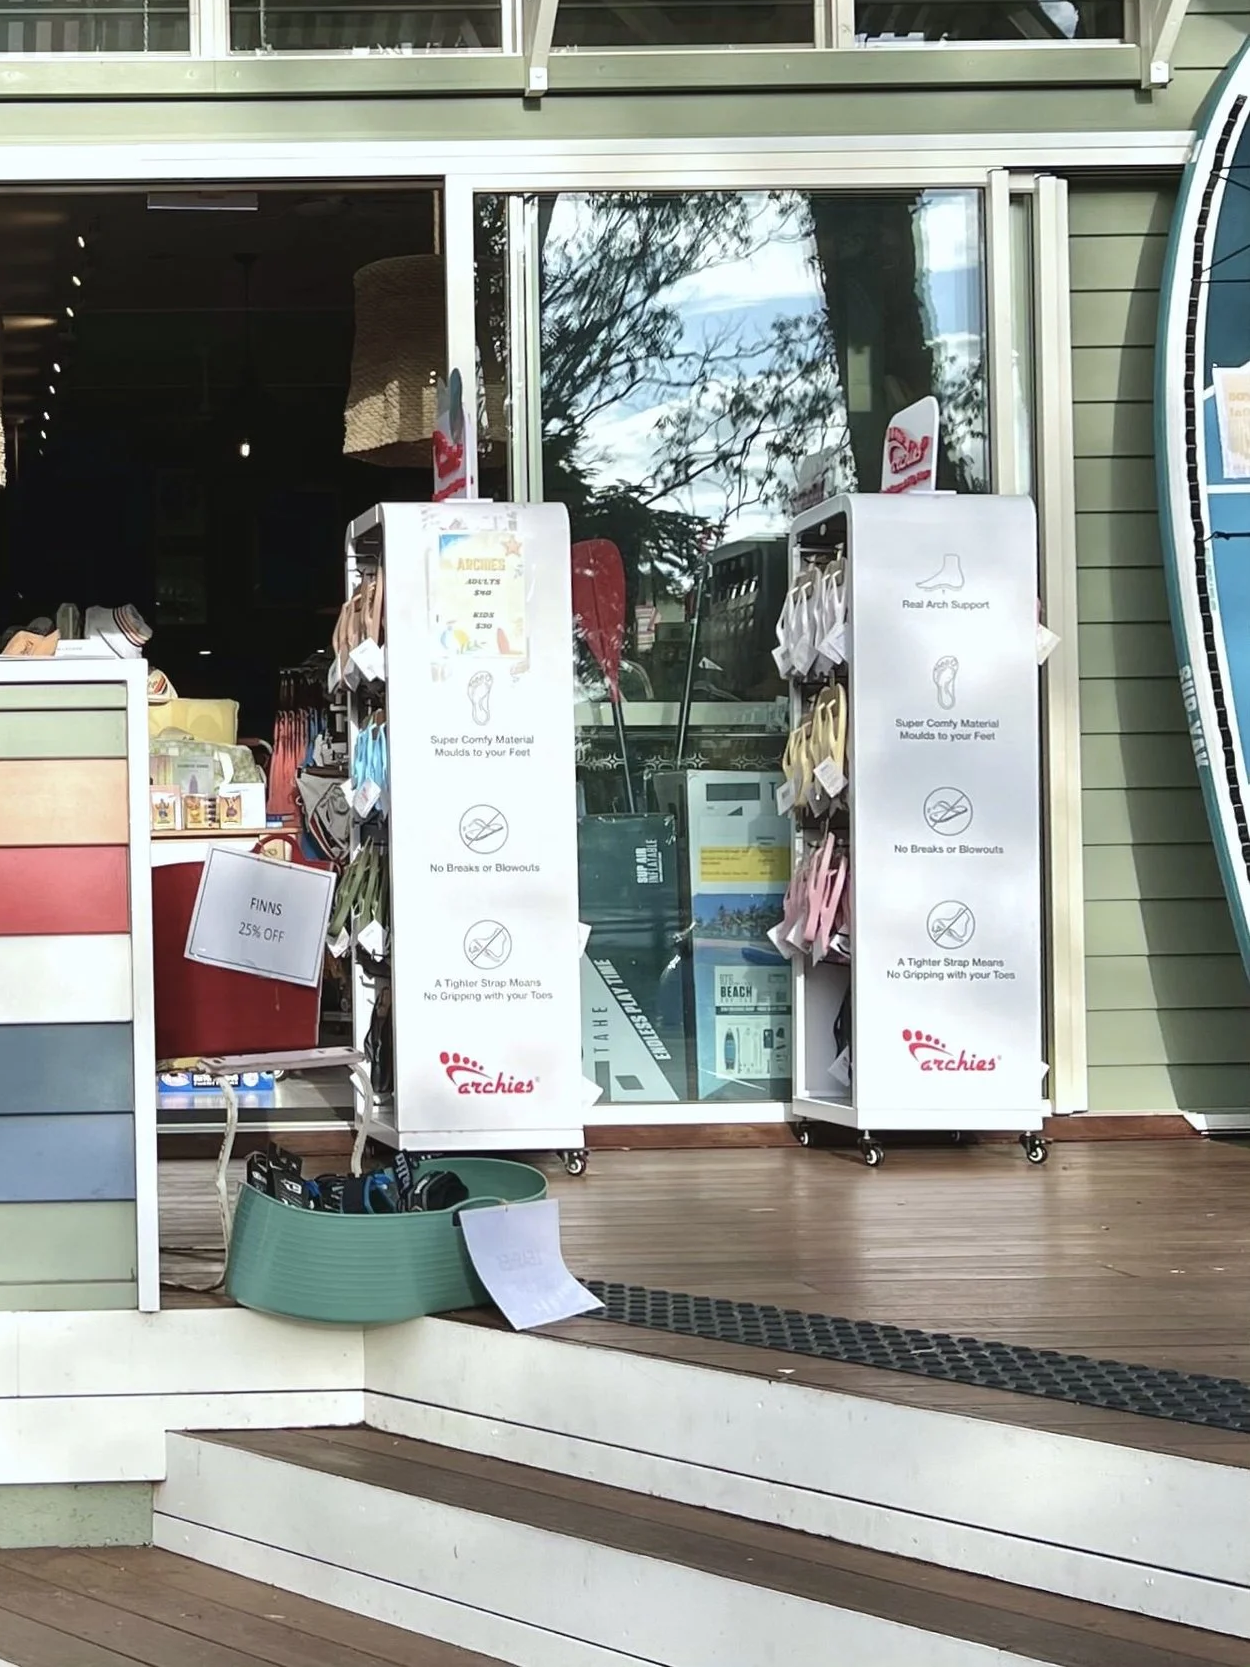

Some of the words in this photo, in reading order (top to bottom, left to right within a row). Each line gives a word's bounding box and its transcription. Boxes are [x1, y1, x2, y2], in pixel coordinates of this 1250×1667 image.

[456, 557, 506, 571] ARCHIES
[902, 599, 924, 609] Real
[926, 599, 948, 609] Arch
[951, 599, 990, 611] Support
[895, 718, 924, 729] Super
[926, 718, 958, 730] Comfy
[961, 718, 1000, 728] Material
[430, 735, 458, 746] Super
[461, 735, 493, 746] Comfy
[496, 735, 534, 744] Material
[899, 731, 935, 740] Moulds
[938, 732, 948, 740] to
[950, 733, 972, 742] your
[974, 731, 996, 740] Feet
[434, 748, 470, 757] Moulds
[473, 748, 483, 757] to
[485, 749, 506, 758] your
[509, 747, 531, 757] Feet
[635, 847, 647, 863] AIR
[894, 844, 908, 854] No
[910, 844, 944, 854] Breaks
[946, 846, 957, 854] or
[959, 844, 1004, 854] Blowouts
[430, 863, 444, 873] No
[447, 863, 480, 872] Breaks
[482, 864, 492, 872] or
[495, 862, 540, 872] Blowouts
[636, 864, 648, 884] SUP
[250, 897, 283, 916] FINNS
[238, 921, 261, 939] 25%
[263, 927, 285, 943] OFF
[897, 958, 905, 967] A
[908, 958, 941, 969] Tighter
[943, 957, 970, 969] Strap
[972, 957, 1004, 967] Means
[886, 970, 901, 980] No
[903, 970, 944, 981] Gripping
[947, 970, 967, 980] with
[969, 971, 991, 982] your
[994, 970, 1016, 980] Toes
[434, 979, 442, 988] A
[444, 978, 478, 989] Tighter
[480, 978, 507, 989] Strap
[509, 978, 541, 987] Means
[423, 991, 438, 1001] No
[440, 991, 482, 1002] Gripping
[484, 991, 504, 1000] with
[506, 992, 527, 1002] your
[530, 990, 553, 1000] Toes
[720, 986, 753, 998] BEACH
[592, 1006, 610, 1054] TAHE
[920, 1050, 996, 1072] archies
[457, 1071, 534, 1094] archies
